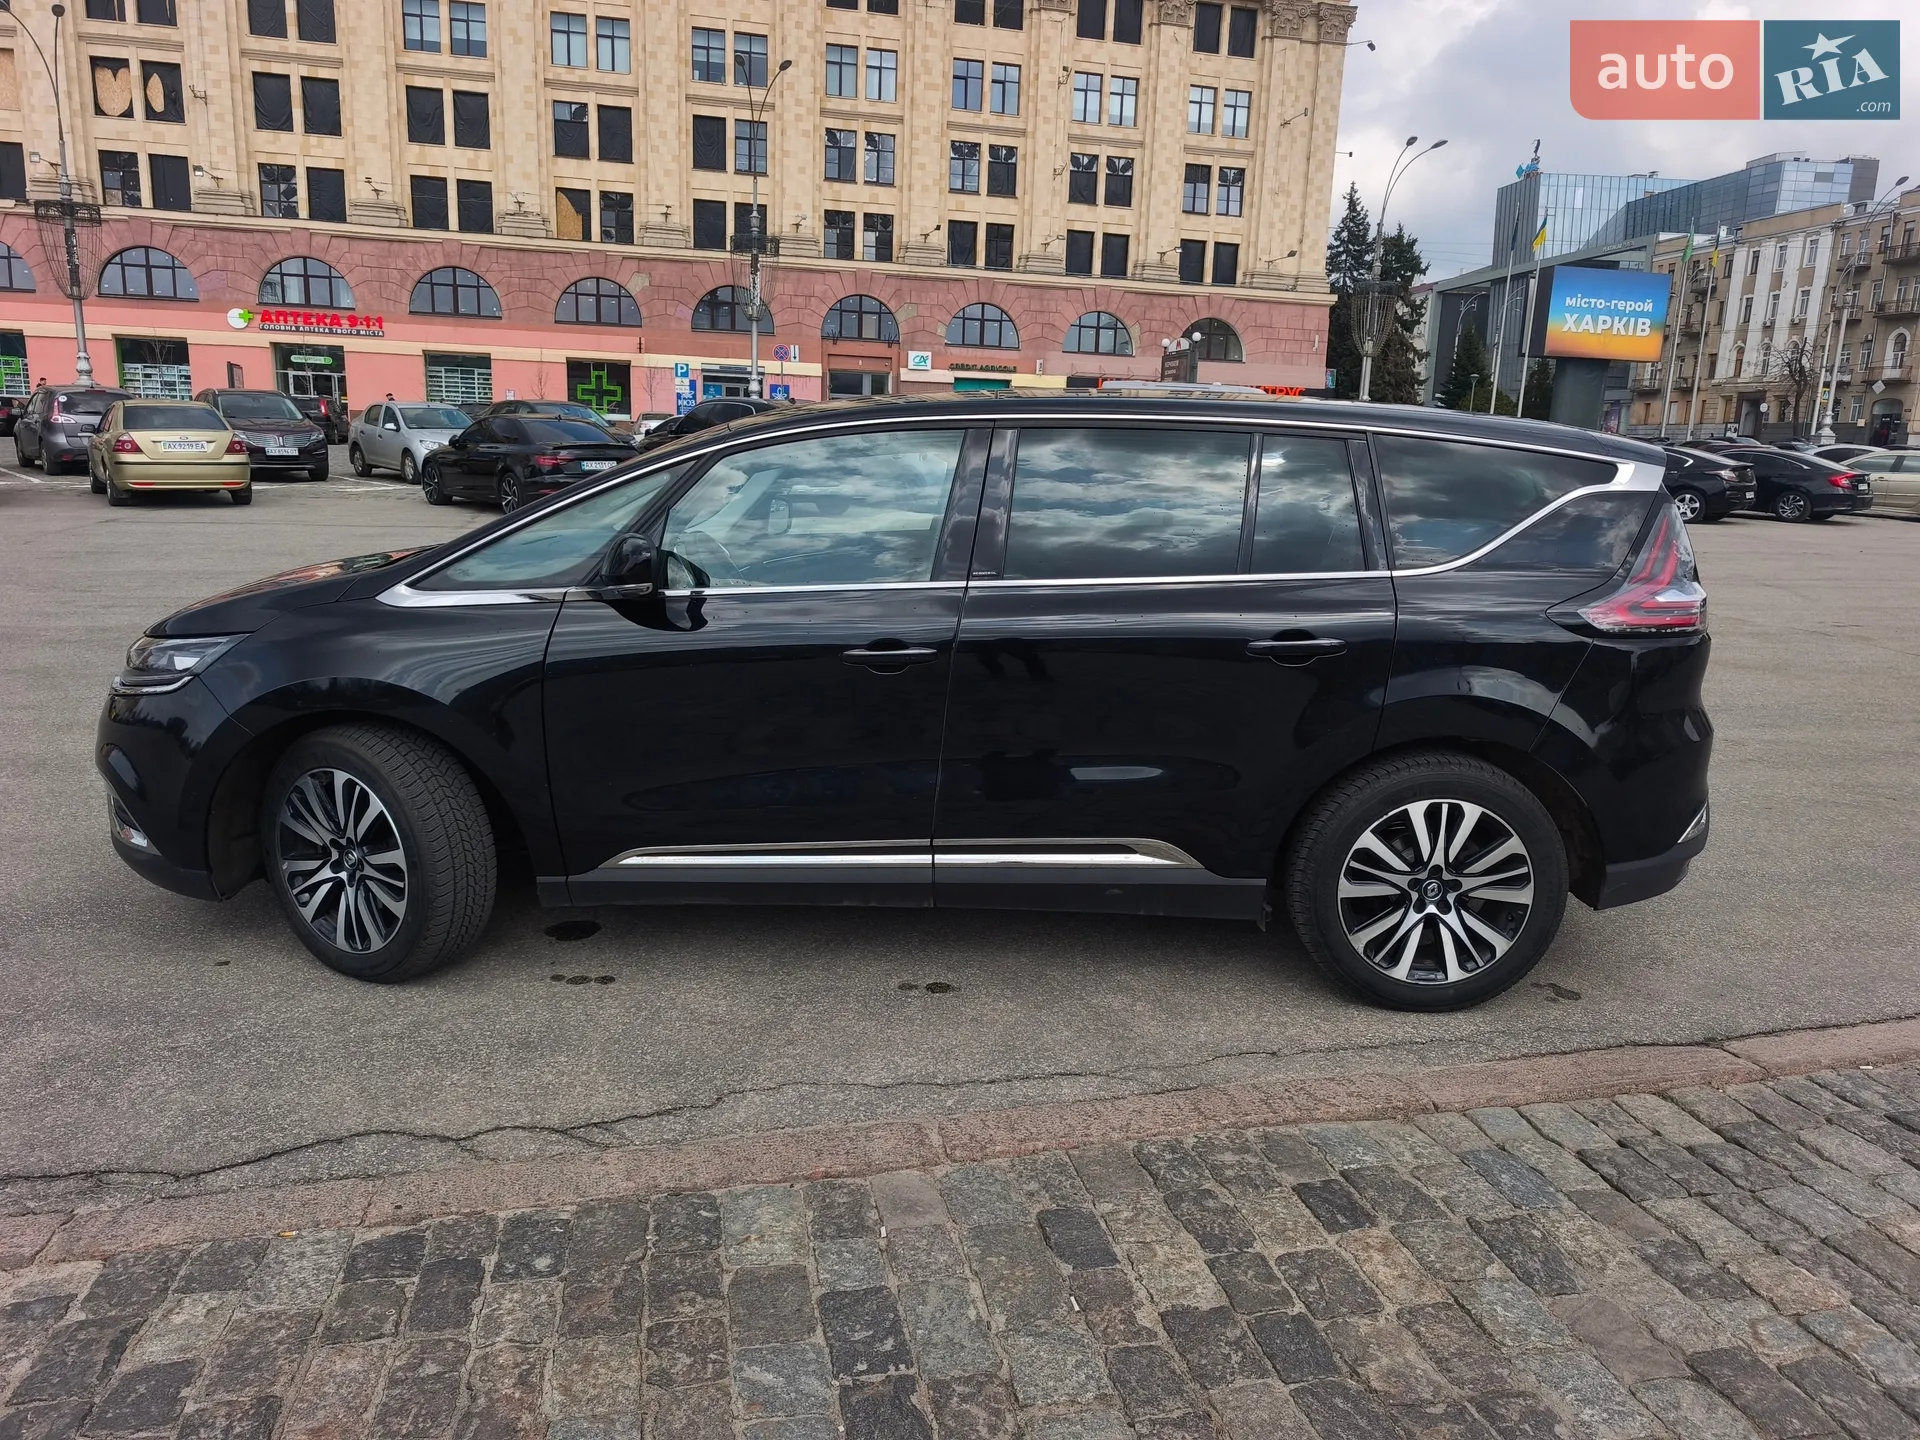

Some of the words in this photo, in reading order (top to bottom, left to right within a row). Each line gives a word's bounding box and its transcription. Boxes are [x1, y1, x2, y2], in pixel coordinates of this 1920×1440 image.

[1565, 294, 1653, 313] місто-герой
[259, 323, 296, 331] ГОЛОВНА
[260, 309, 342, 327] АПТЕКА
[1562, 313, 1651, 336] ХАРКІВ
[677, 364, 687, 376] P
